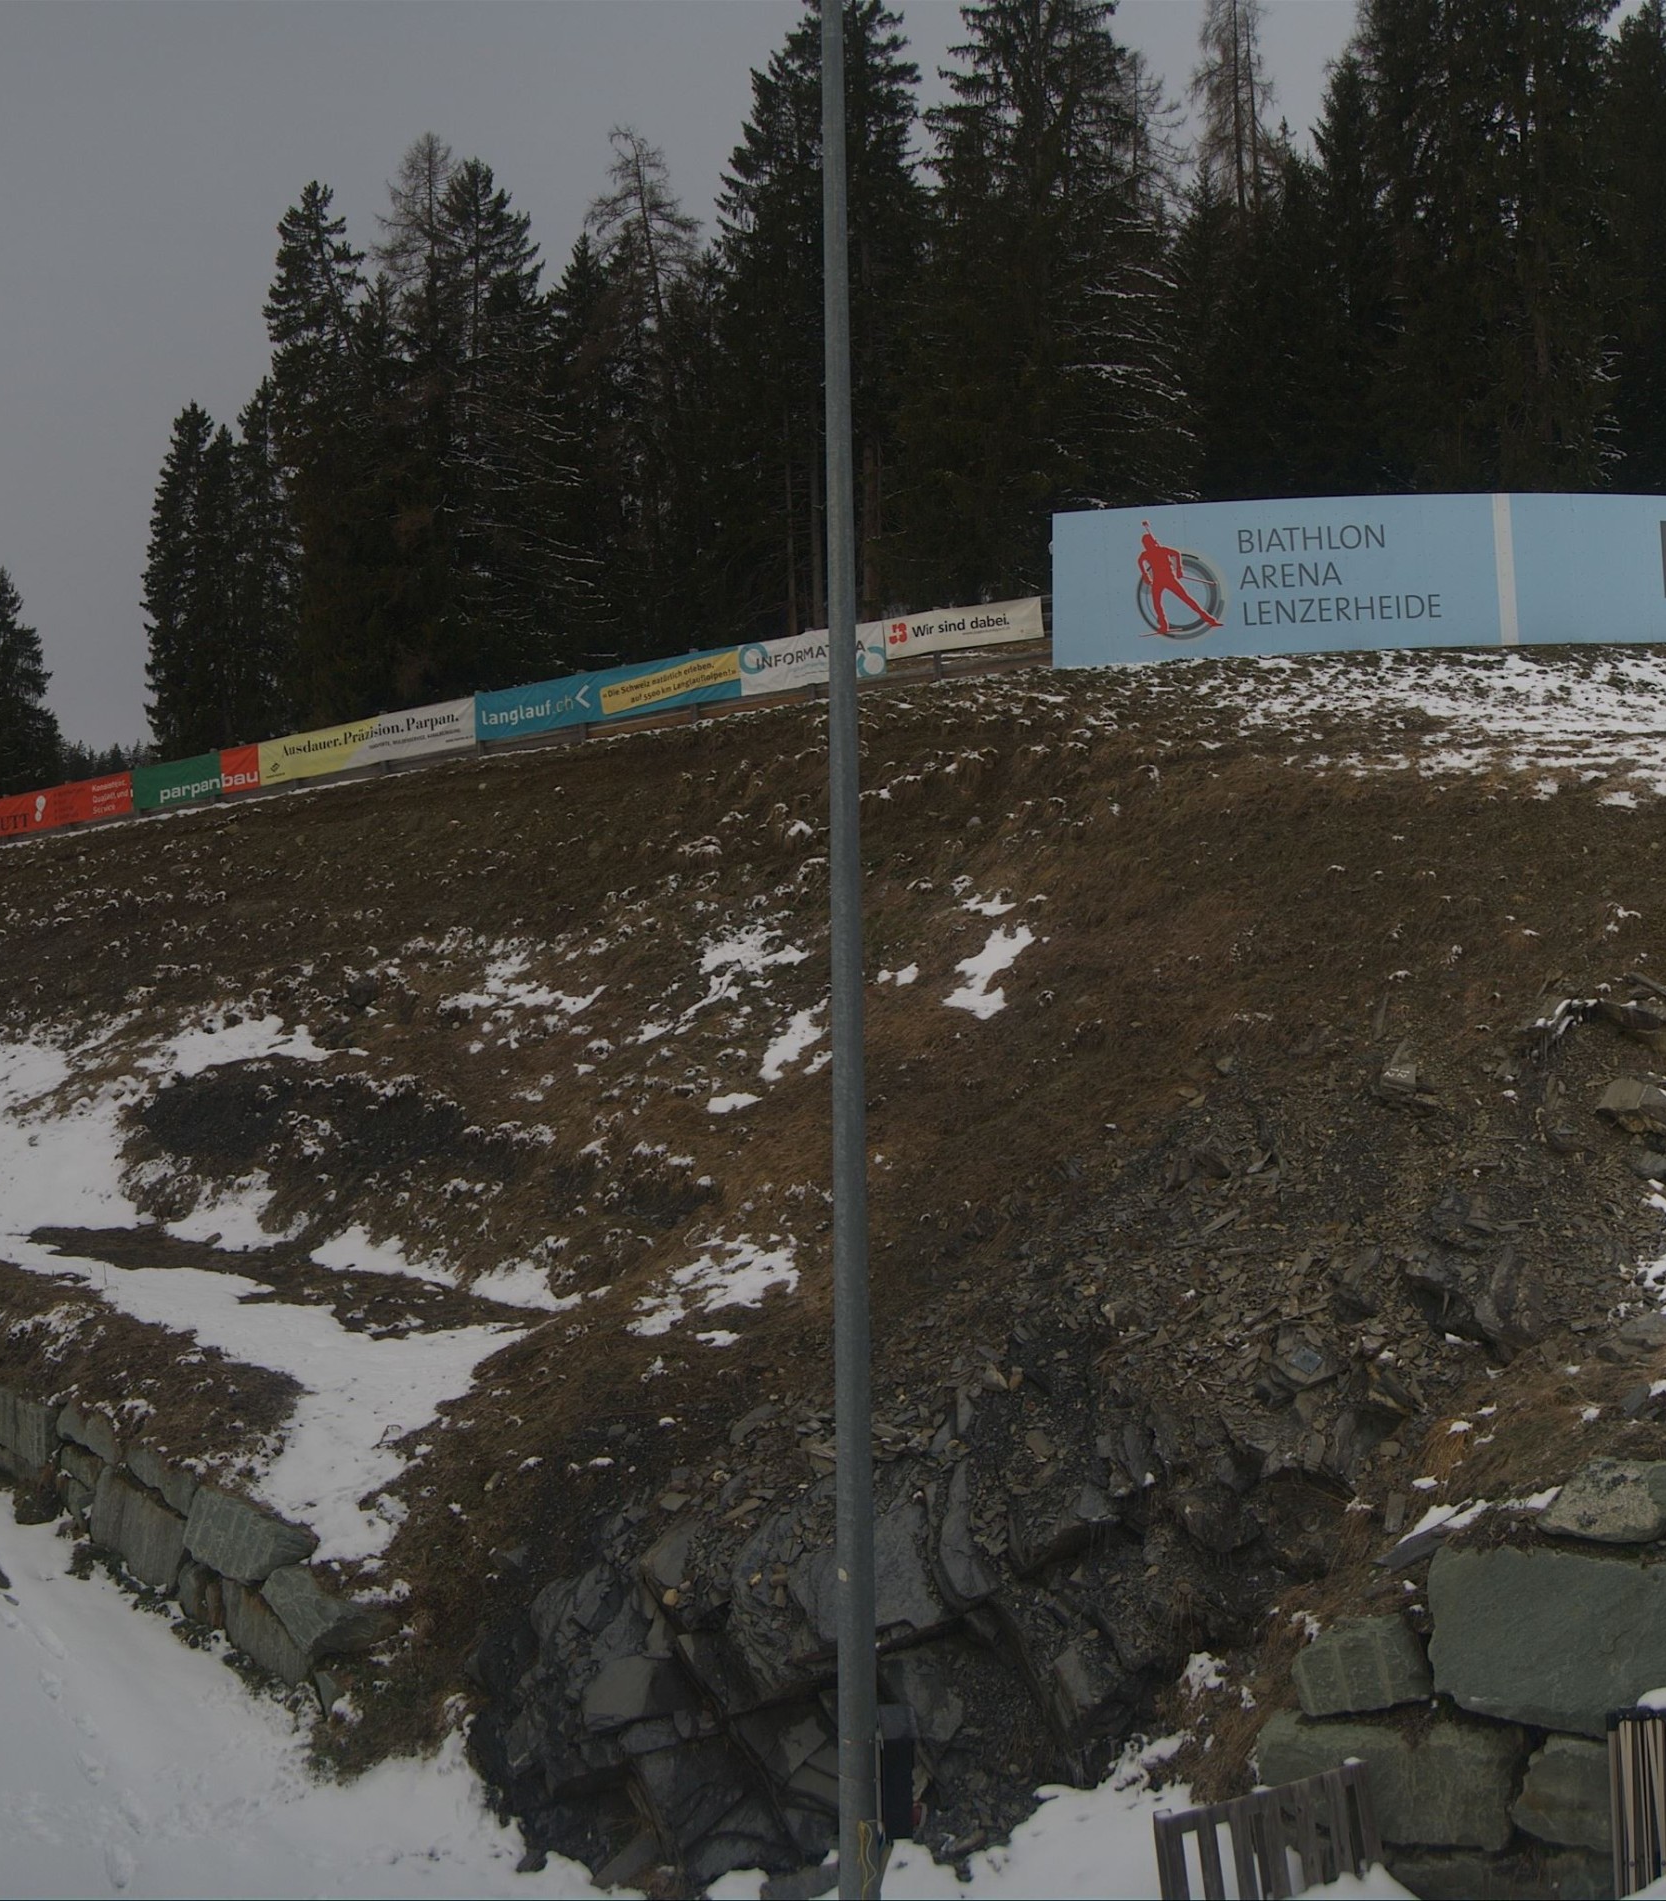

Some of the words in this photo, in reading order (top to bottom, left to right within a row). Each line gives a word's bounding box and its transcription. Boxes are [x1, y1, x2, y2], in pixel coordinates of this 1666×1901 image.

[1238, 524, 1385, 554] BIATHLON
[1240, 561, 1343, 590] ARENA
[1243, 594, 1442, 626] LENZERHEIDE
[912, 624, 934, 638] Wir
[938, 618, 965, 633] sind
[970, 613, 1010, 629] dabei.
[620, 680, 650, 693] Schweiz
[482, 694, 574, 725] langlauf.ch
[283, 736, 342, 757] Ausdauer.
[343, 724, 404, 745] Präzision.
[405, 713, 459, 732] Parpan.
[160, 771, 258, 803] parpanbau
